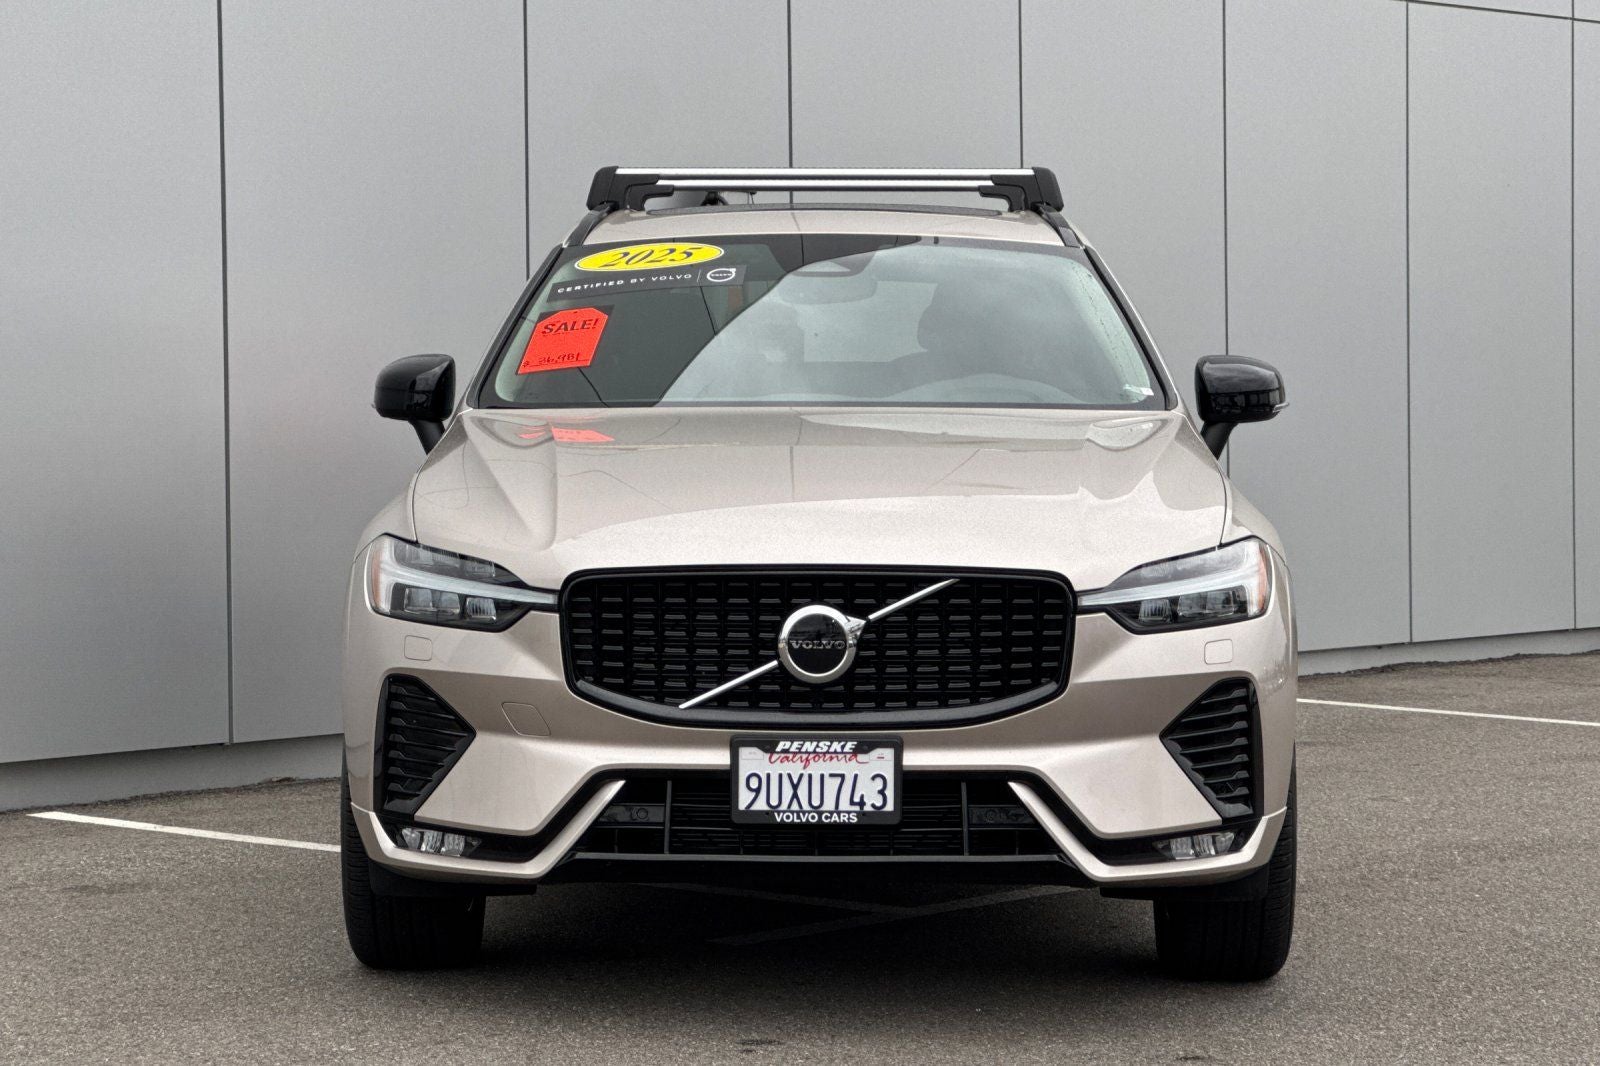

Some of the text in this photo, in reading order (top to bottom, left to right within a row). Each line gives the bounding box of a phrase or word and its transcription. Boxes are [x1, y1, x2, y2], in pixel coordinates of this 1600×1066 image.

[599, 246, 704, 269] 2025
[557, 273, 693, 294] CERTIFIED BY VOLVO
[541, 318, 599, 335] SALE!
[789, 639, 846, 650] VOLVO
[775, 741, 857, 752] PENSKE
[768, 752, 869, 770] California
[744, 772, 888, 811] 9UXU743
[774, 812, 858, 823] VOLVO CARS
